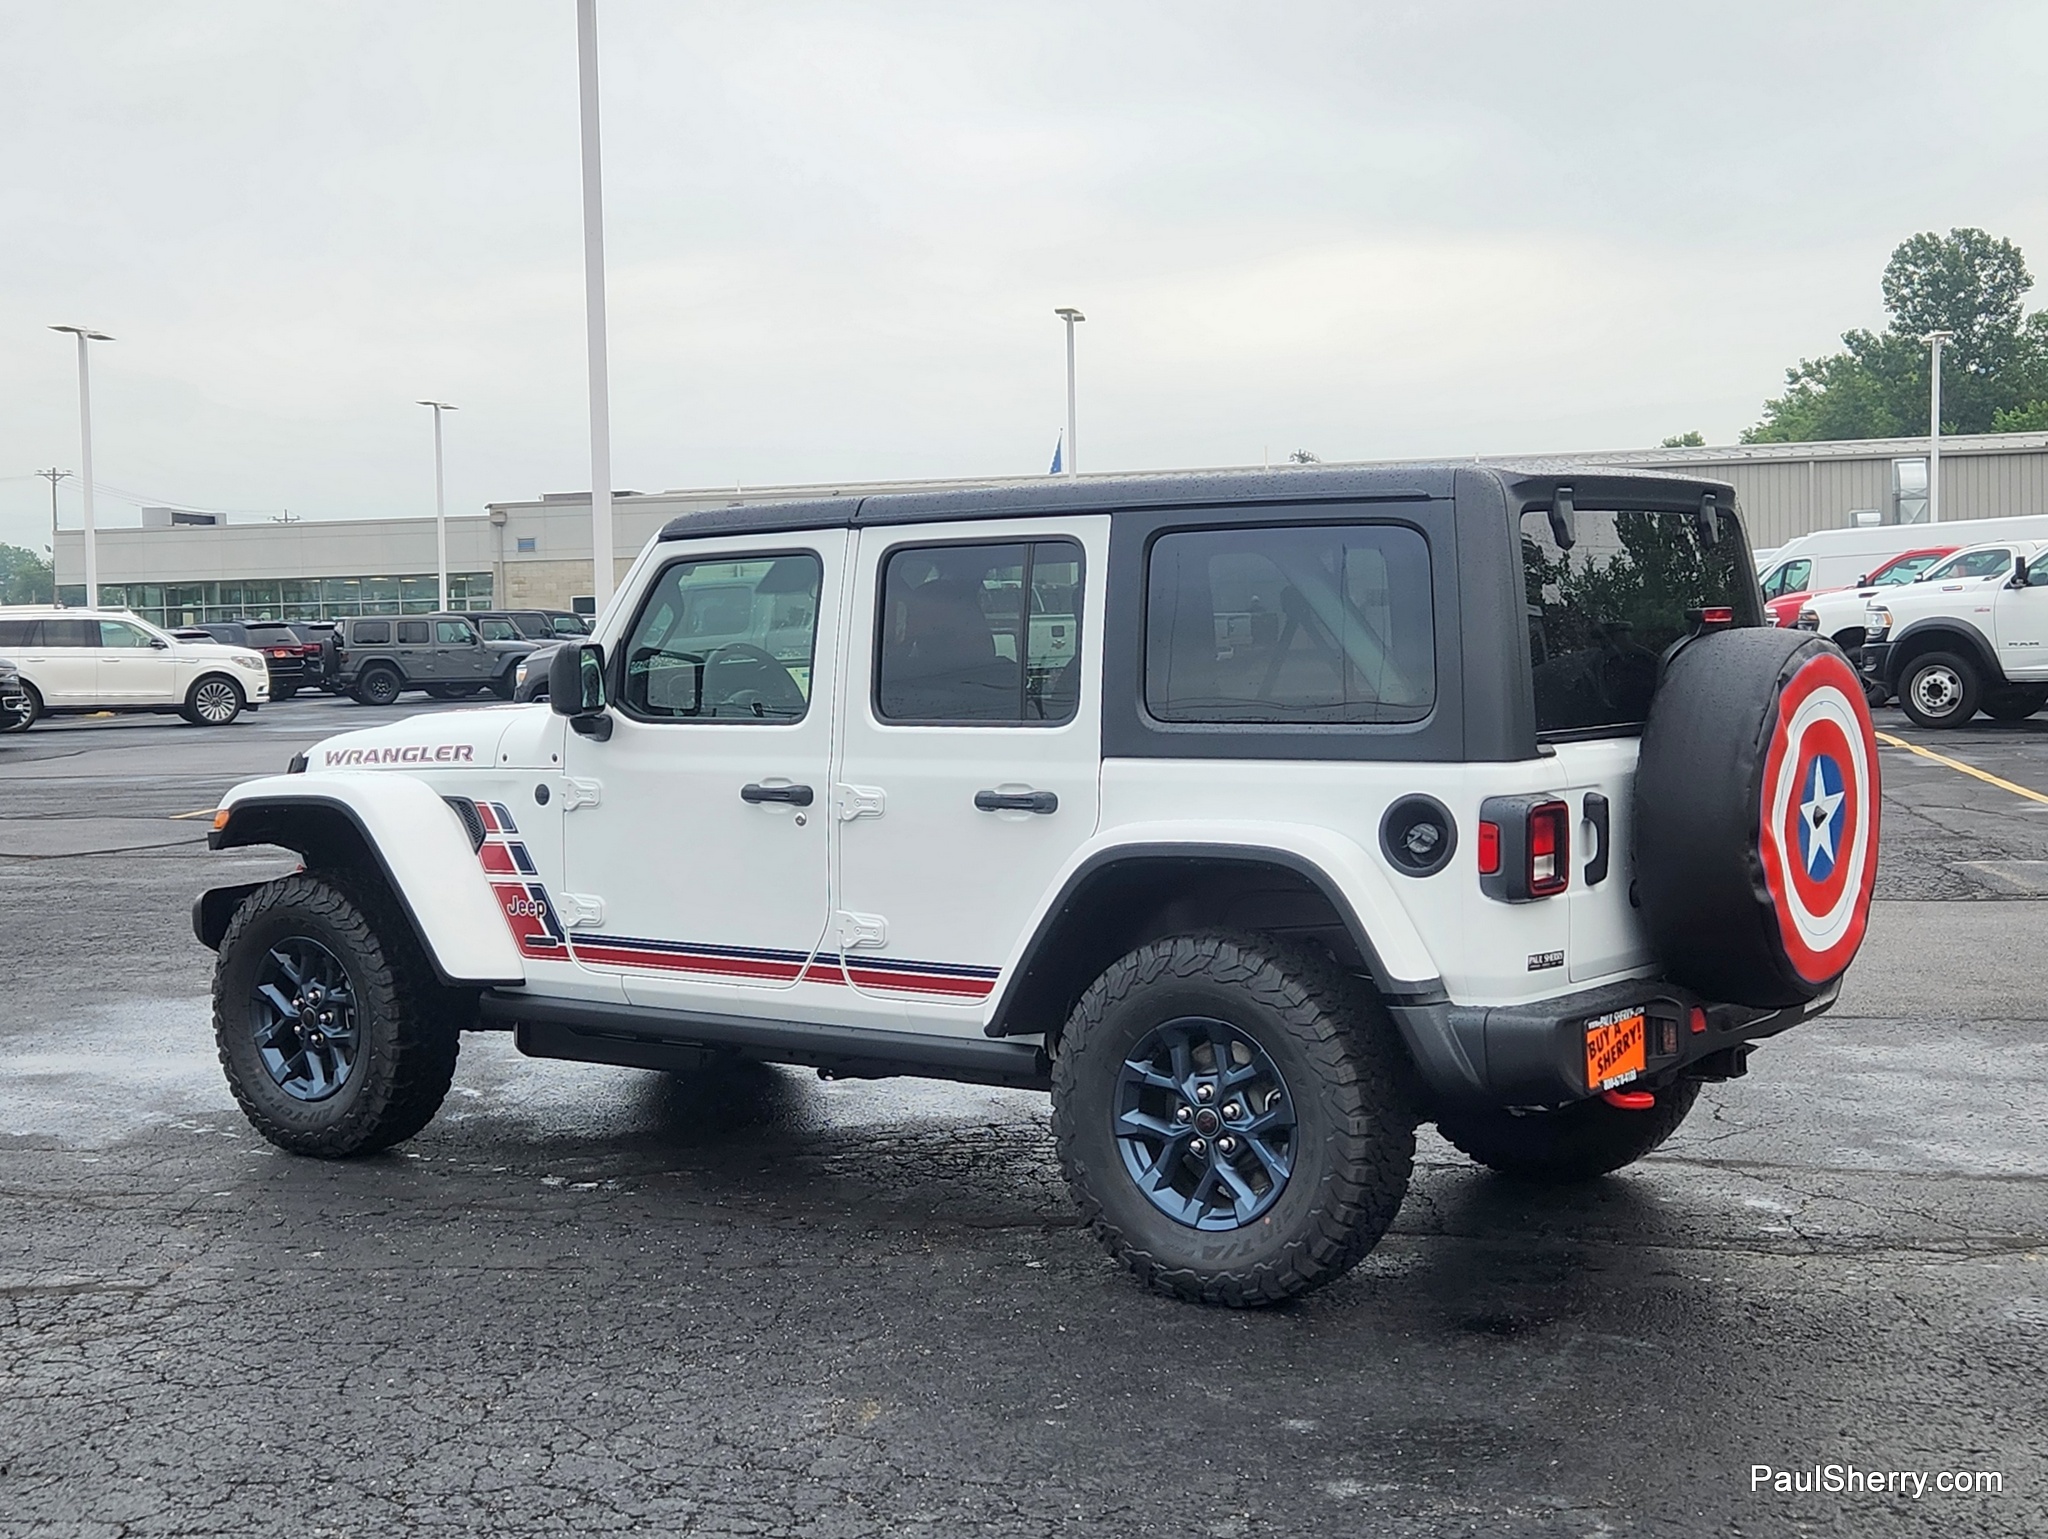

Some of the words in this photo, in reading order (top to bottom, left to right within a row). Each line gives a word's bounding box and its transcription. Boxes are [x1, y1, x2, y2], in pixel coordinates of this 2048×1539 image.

[325, 744, 474, 767] WRANGLER
[507, 895, 546, 919] Jeep
[1528, 955, 1543, 965] PAUL
[1588, 1027, 1610, 1061] BUY
[1614, 1023, 1622, 1039] A
[1597, 1021, 1642, 1077] SHERRY!
